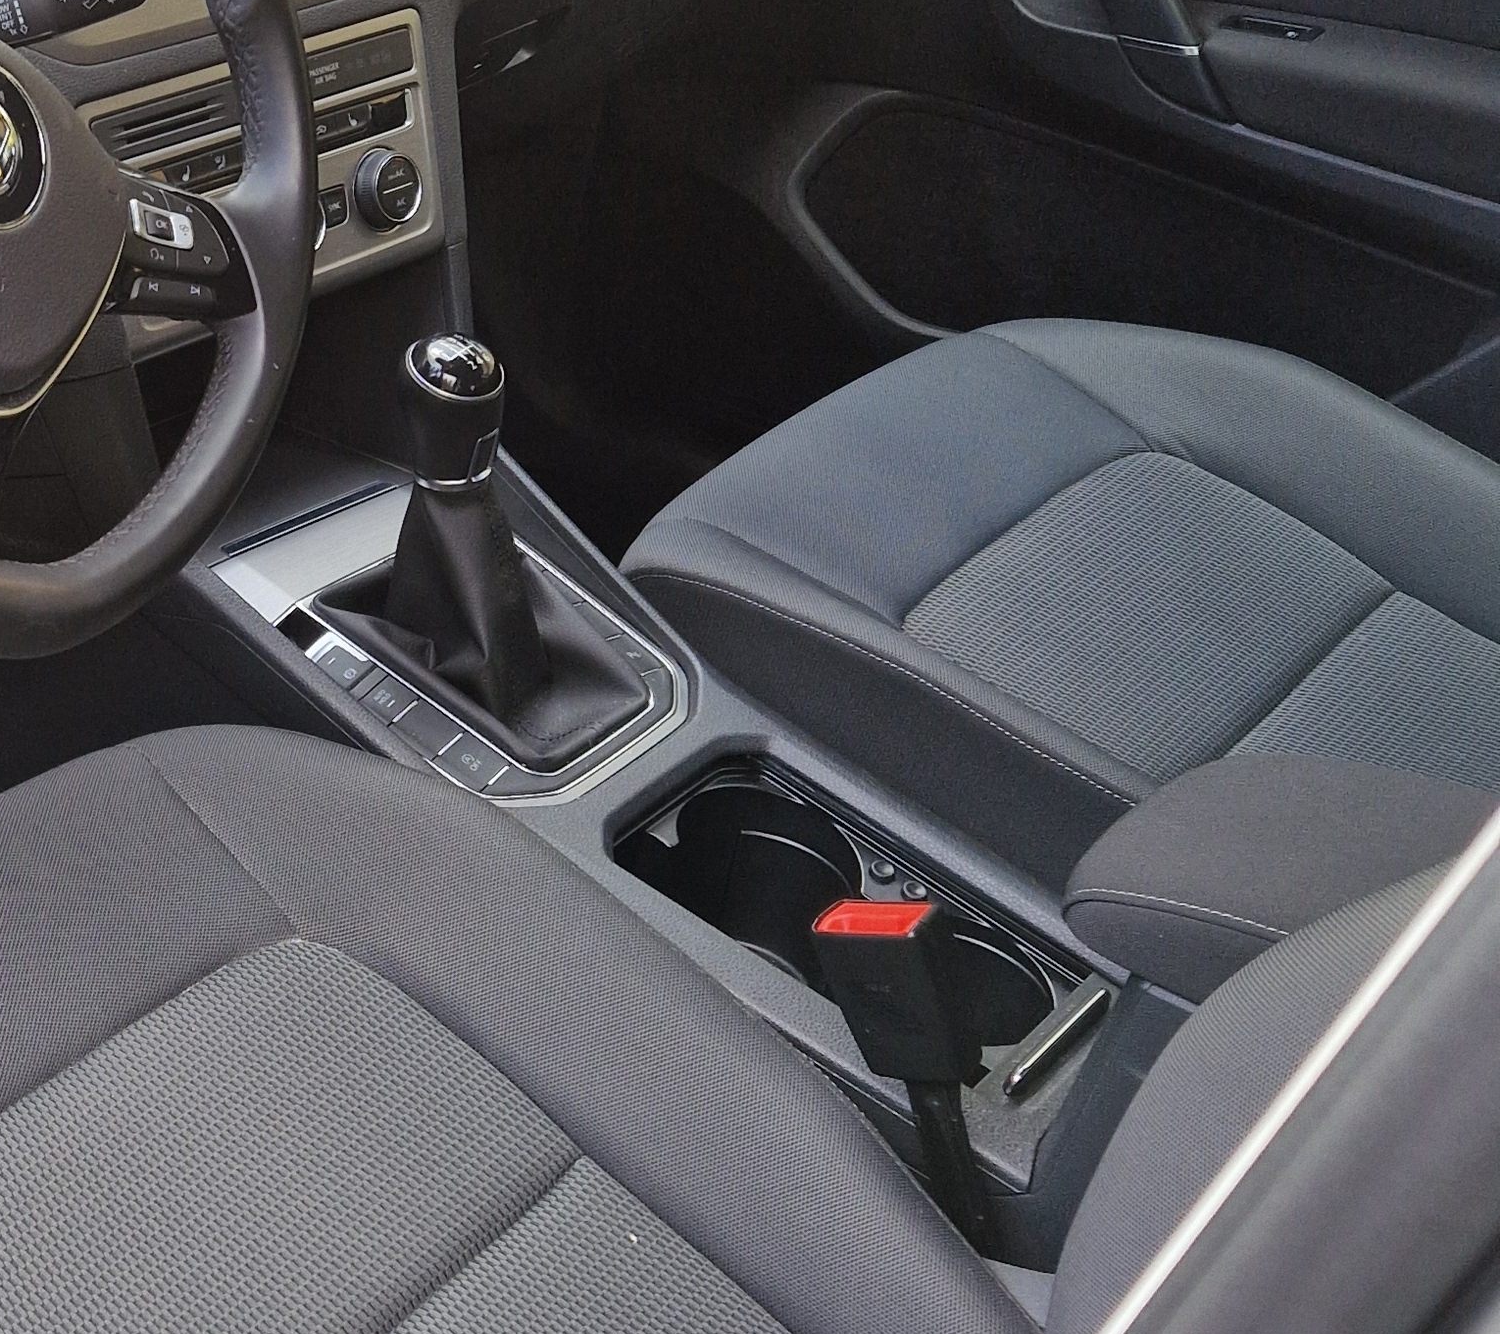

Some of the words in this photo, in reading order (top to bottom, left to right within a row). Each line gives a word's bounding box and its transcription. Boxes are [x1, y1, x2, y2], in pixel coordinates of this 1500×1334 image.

[0, 11, 13, 23] INT
[1, 20, 15, 30] OFF
[467, 360, 478, 371] 2
